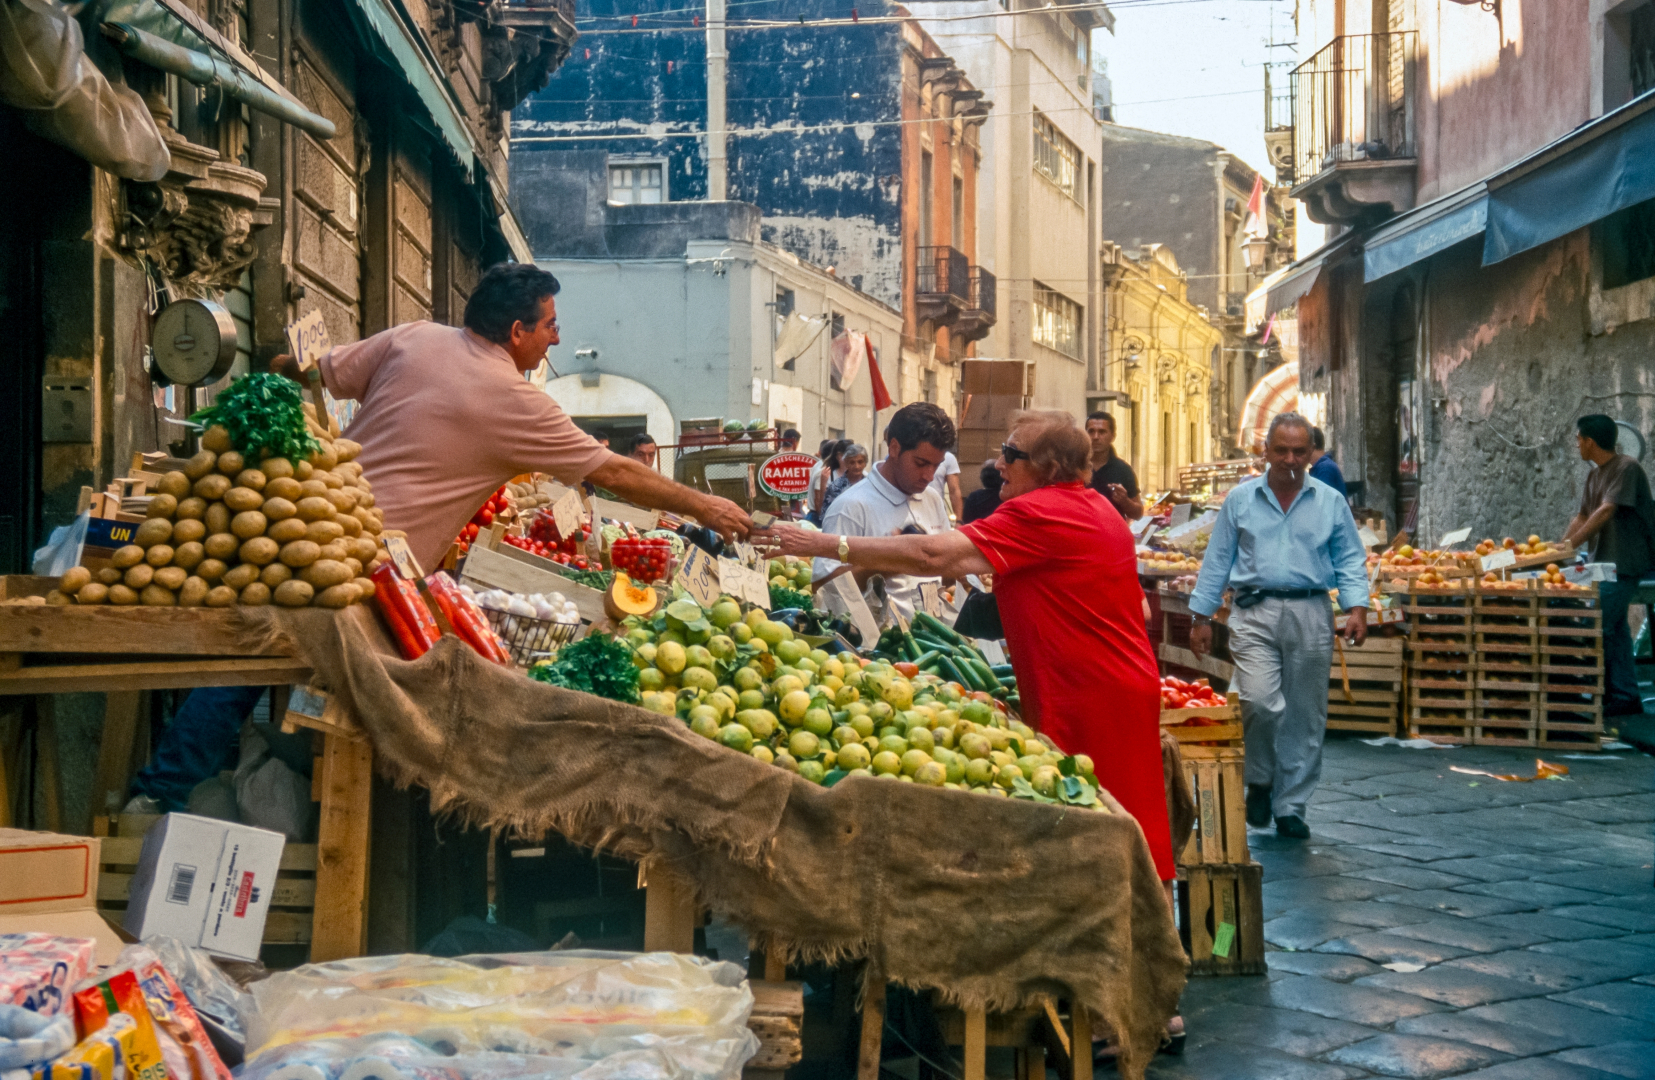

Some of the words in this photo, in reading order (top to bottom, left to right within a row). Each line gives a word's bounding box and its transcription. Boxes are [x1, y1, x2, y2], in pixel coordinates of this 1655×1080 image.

[297, 321, 324, 363] 1000
[773, 455, 813, 465] FRESCHEZZA
[110, 527, 131, 541] UN
